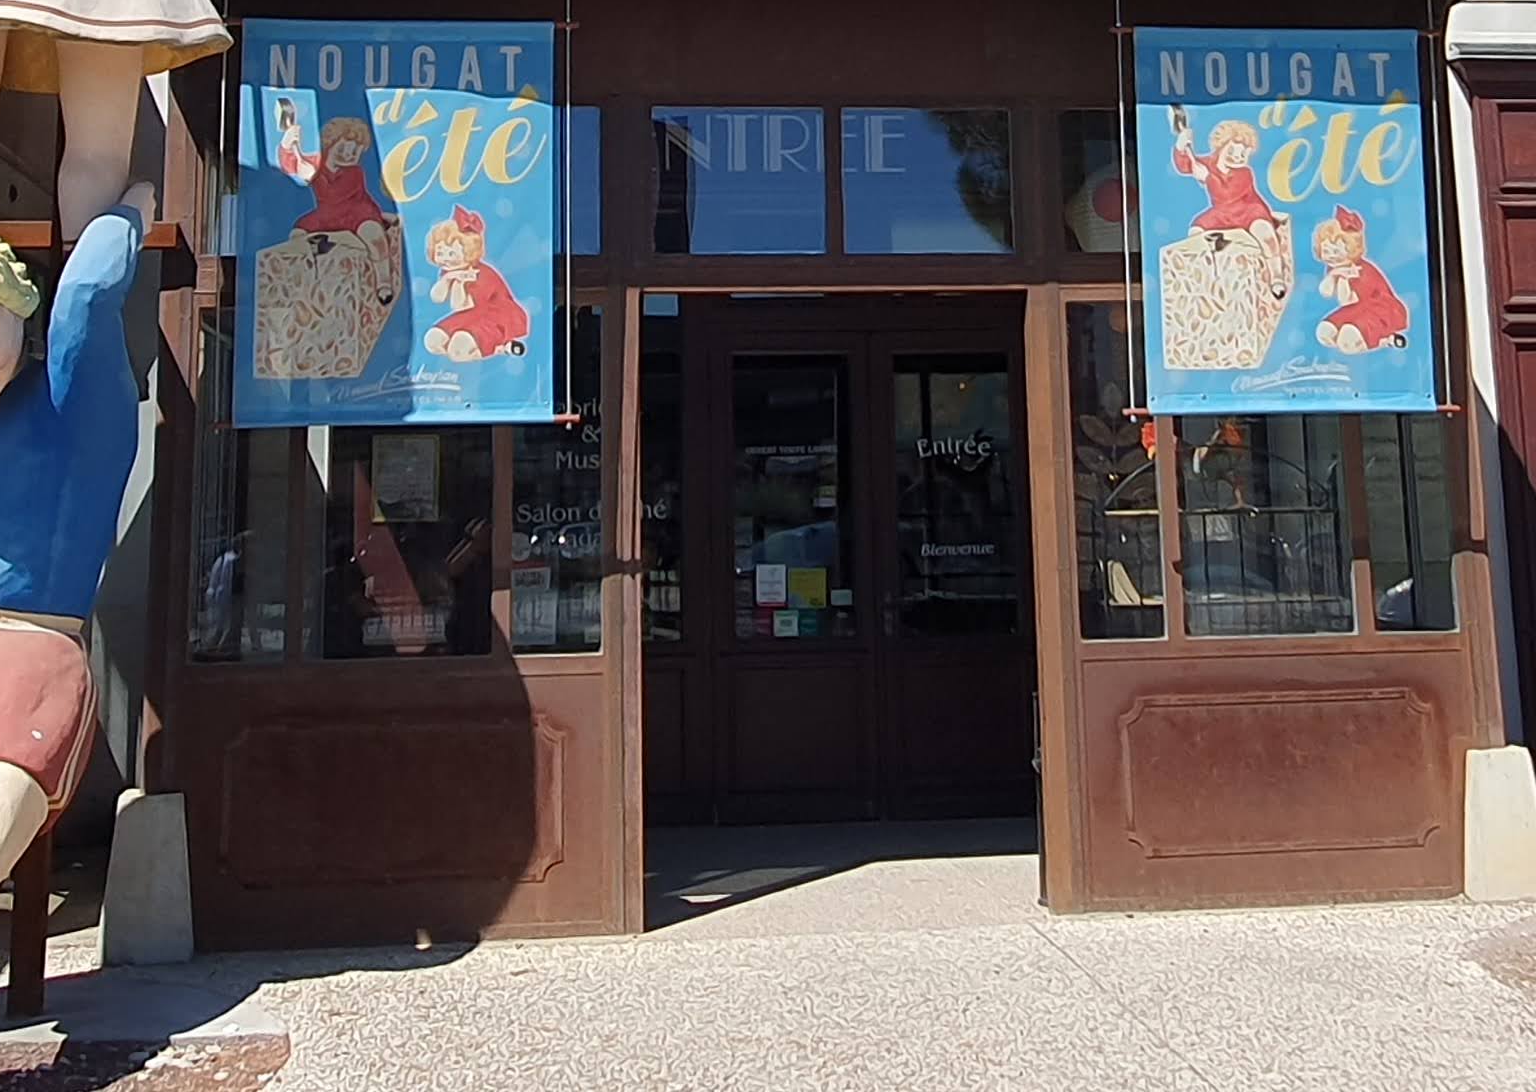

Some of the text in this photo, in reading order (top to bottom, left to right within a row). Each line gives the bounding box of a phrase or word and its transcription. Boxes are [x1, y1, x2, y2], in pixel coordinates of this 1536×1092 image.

[268, 43, 524, 92] NOUGAT
[1159, 50, 1391, 98] NOUGAT
[916, 434, 992, 459] Entrée
[516, 503, 581, 524] Salon
[920, 542, 995, 557] Bienvenue
